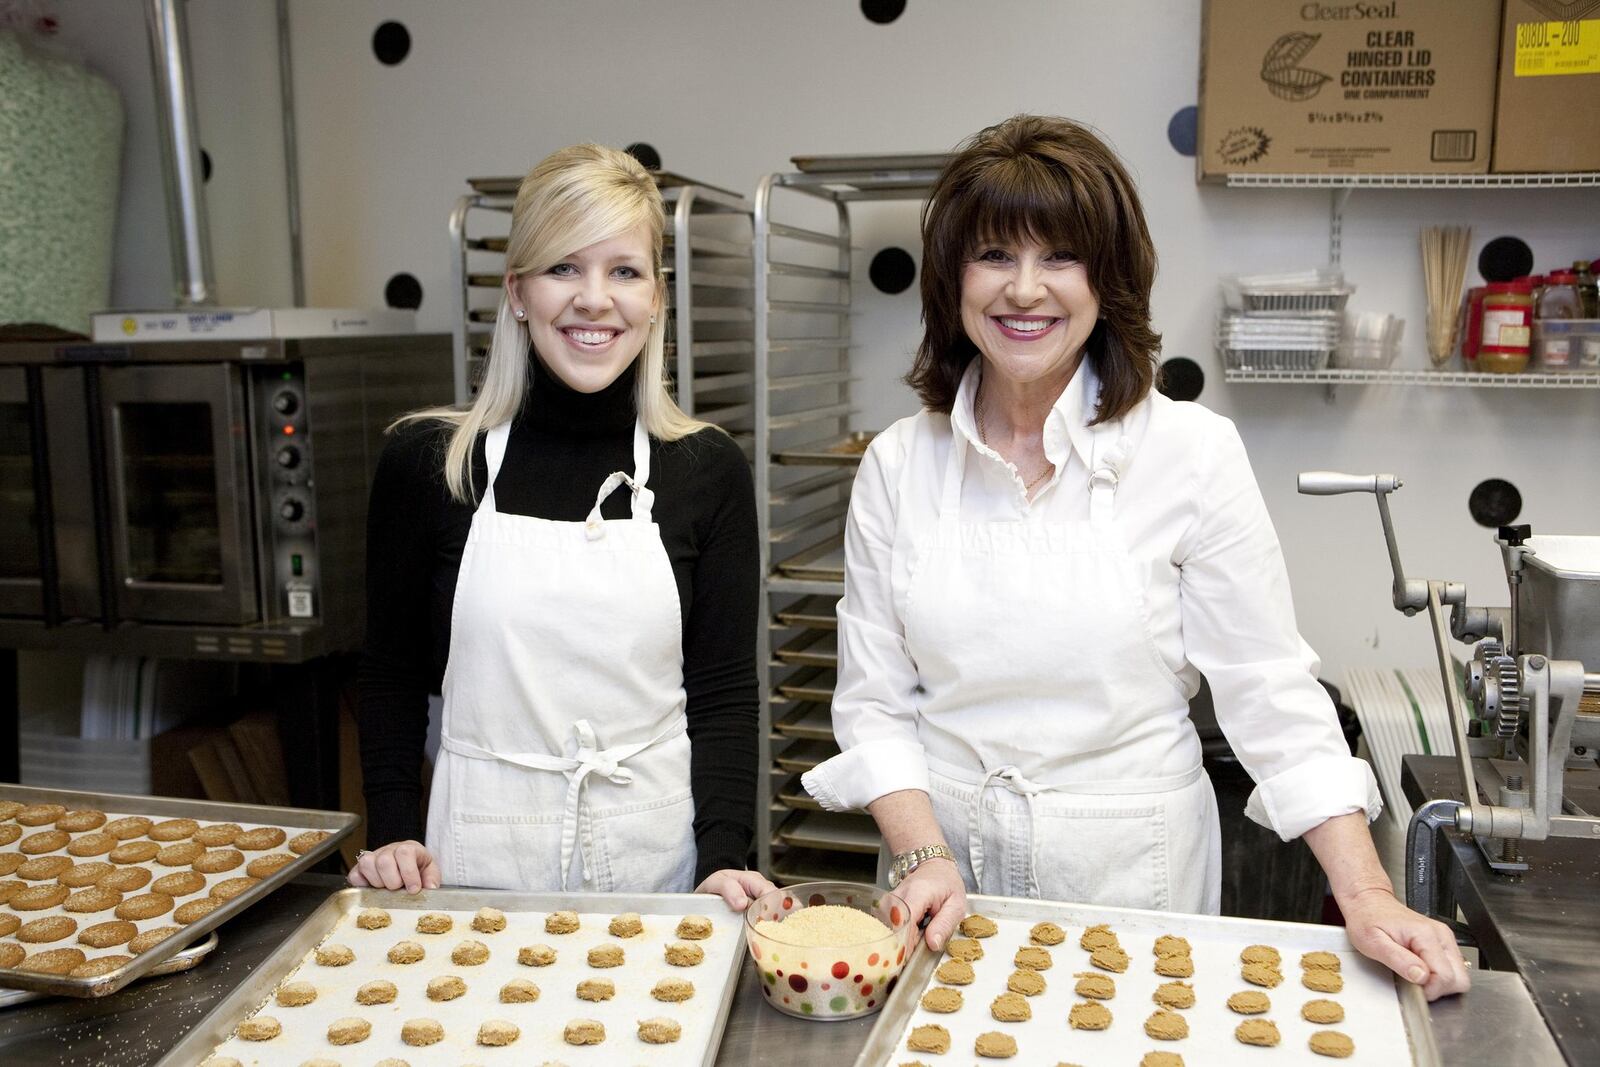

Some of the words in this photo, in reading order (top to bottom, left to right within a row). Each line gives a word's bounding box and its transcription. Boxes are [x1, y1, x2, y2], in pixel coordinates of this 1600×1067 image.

[1300, 0, 1396, 21] ClearSeal
[1366, 30, 1415, 48] CLEAR
[1347, 50, 1403, 68] HINGED
[1407, 49, 1431, 67] LID
[1340, 69, 1436, 87] CONTAINERS
[1344, 89, 1361, 100] ONE
[1363, 88, 1430, 100] COMPARTMENT
